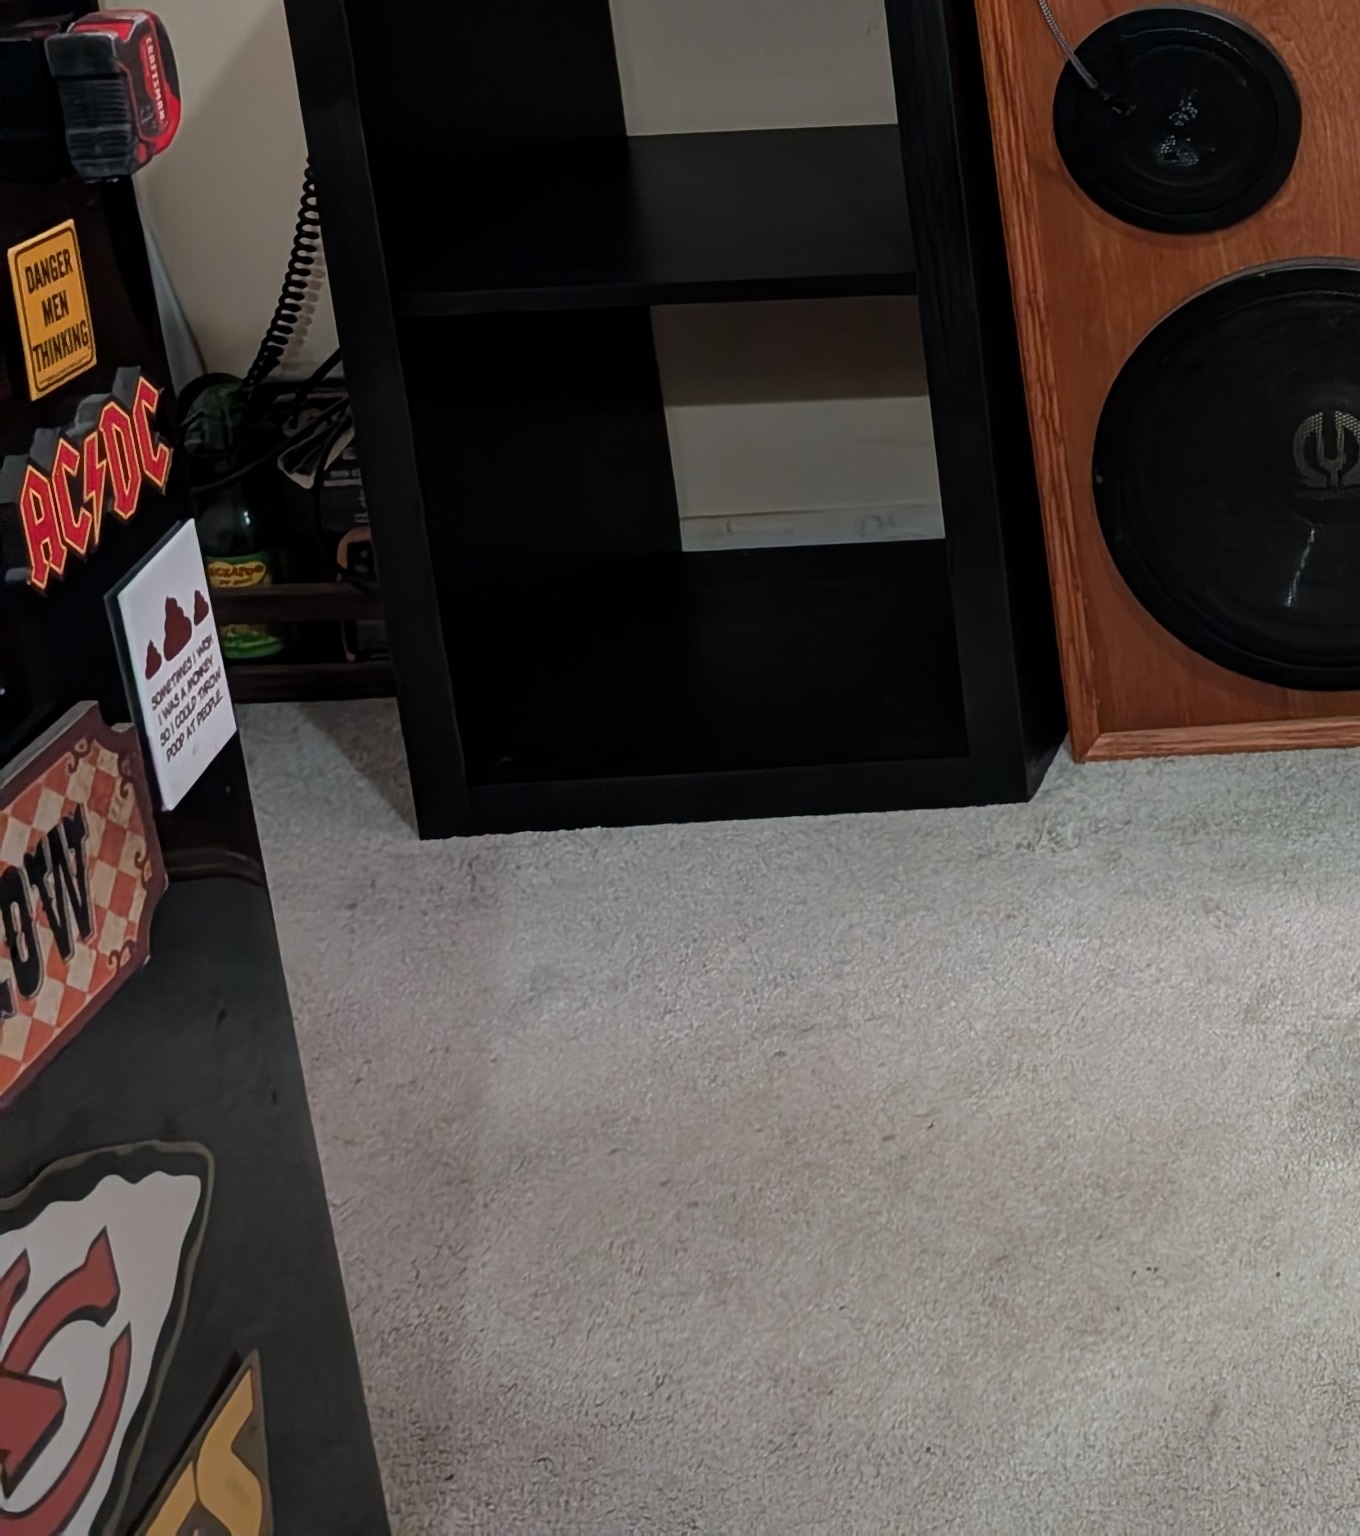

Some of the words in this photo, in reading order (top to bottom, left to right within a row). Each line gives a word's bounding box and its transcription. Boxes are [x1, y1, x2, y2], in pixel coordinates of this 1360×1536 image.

[25, 247, 74, 294] DANGER
[41, 289, 70, 328] MEN
[32, 319, 90, 373] THINKING
[162, 693, 180, 720] WAS
[166, 733, 186, 763] POOP
[186, 719, 196, 740] AT
